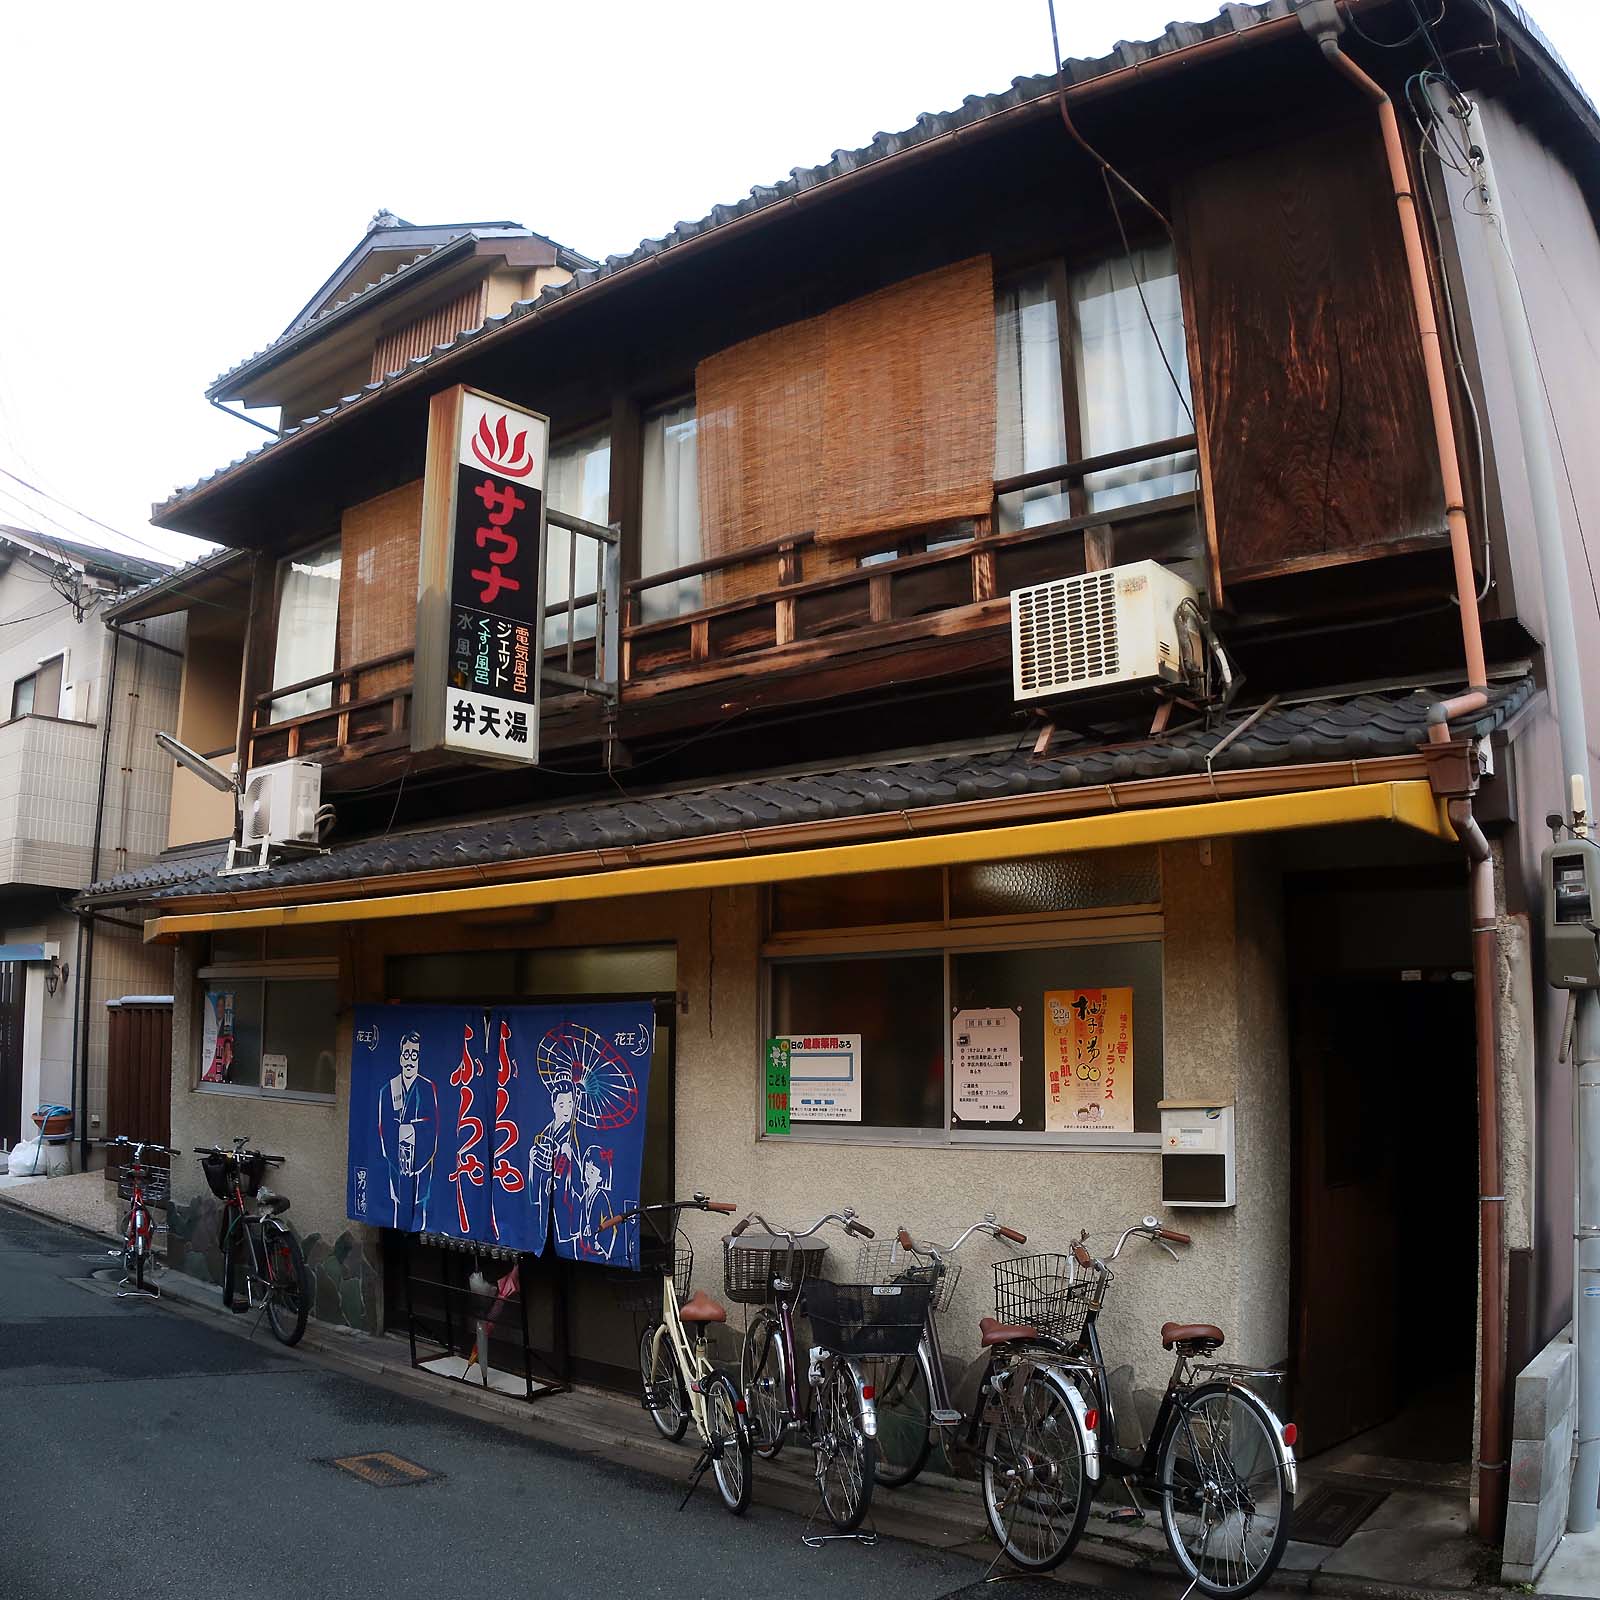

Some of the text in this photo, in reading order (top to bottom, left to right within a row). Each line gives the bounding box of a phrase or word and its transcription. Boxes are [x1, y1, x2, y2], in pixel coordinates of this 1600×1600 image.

[471, 480, 526, 603] サウナ
[475, 618, 491, 684] くすり風呂
[453, 700, 528, 743] 弁天湯
[1053, 1008, 1070, 1019] 22日
[1071, 995, 1101, 1063] 柚子湯
[356, 1030, 373, 1042] 花王
[614, 1032, 635, 1046] 花王
[769, 1074, 787, 1087] こども
[1049, 1071, 1060, 1103] 健康に
[1104, 1043, 1115, 1099] リラックス
[769, 1116, 787, 1128] のいえ
[357, 1170, 367, 1213] 男湯
